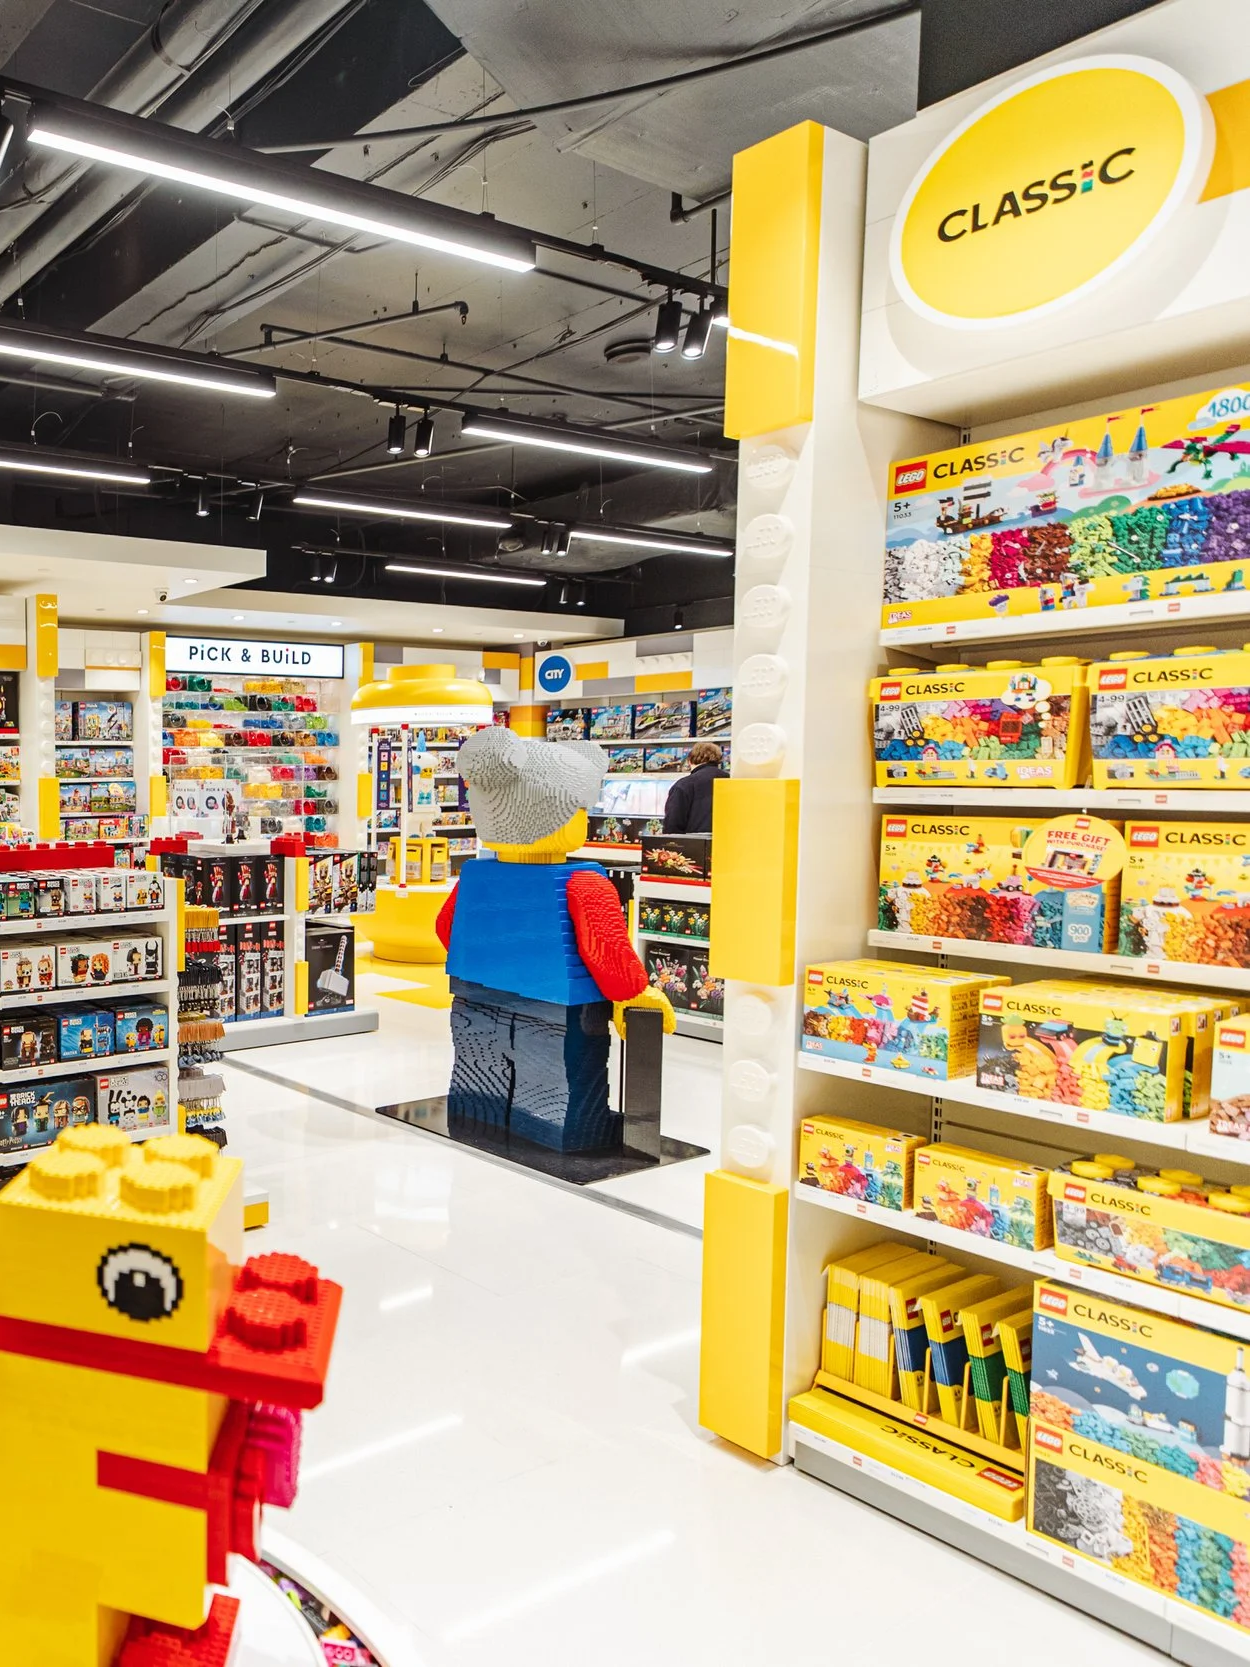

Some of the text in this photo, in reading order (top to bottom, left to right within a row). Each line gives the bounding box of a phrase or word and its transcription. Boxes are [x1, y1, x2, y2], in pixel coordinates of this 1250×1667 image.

[893, 501, 911, 513] 5+
[241, 648, 251, 663] &
[544, 668, 565, 680] CITY
[1047, 830, 1111, 846] FREE GIFT
[885, 844, 897, 852] 5+
[1129, 855, 1145, 864] 5+
[1069, 924, 1091, 936] 900
[16, 1090, 36, 1099] BRICK
[1038, 1316, 1055, 1328] 5+
